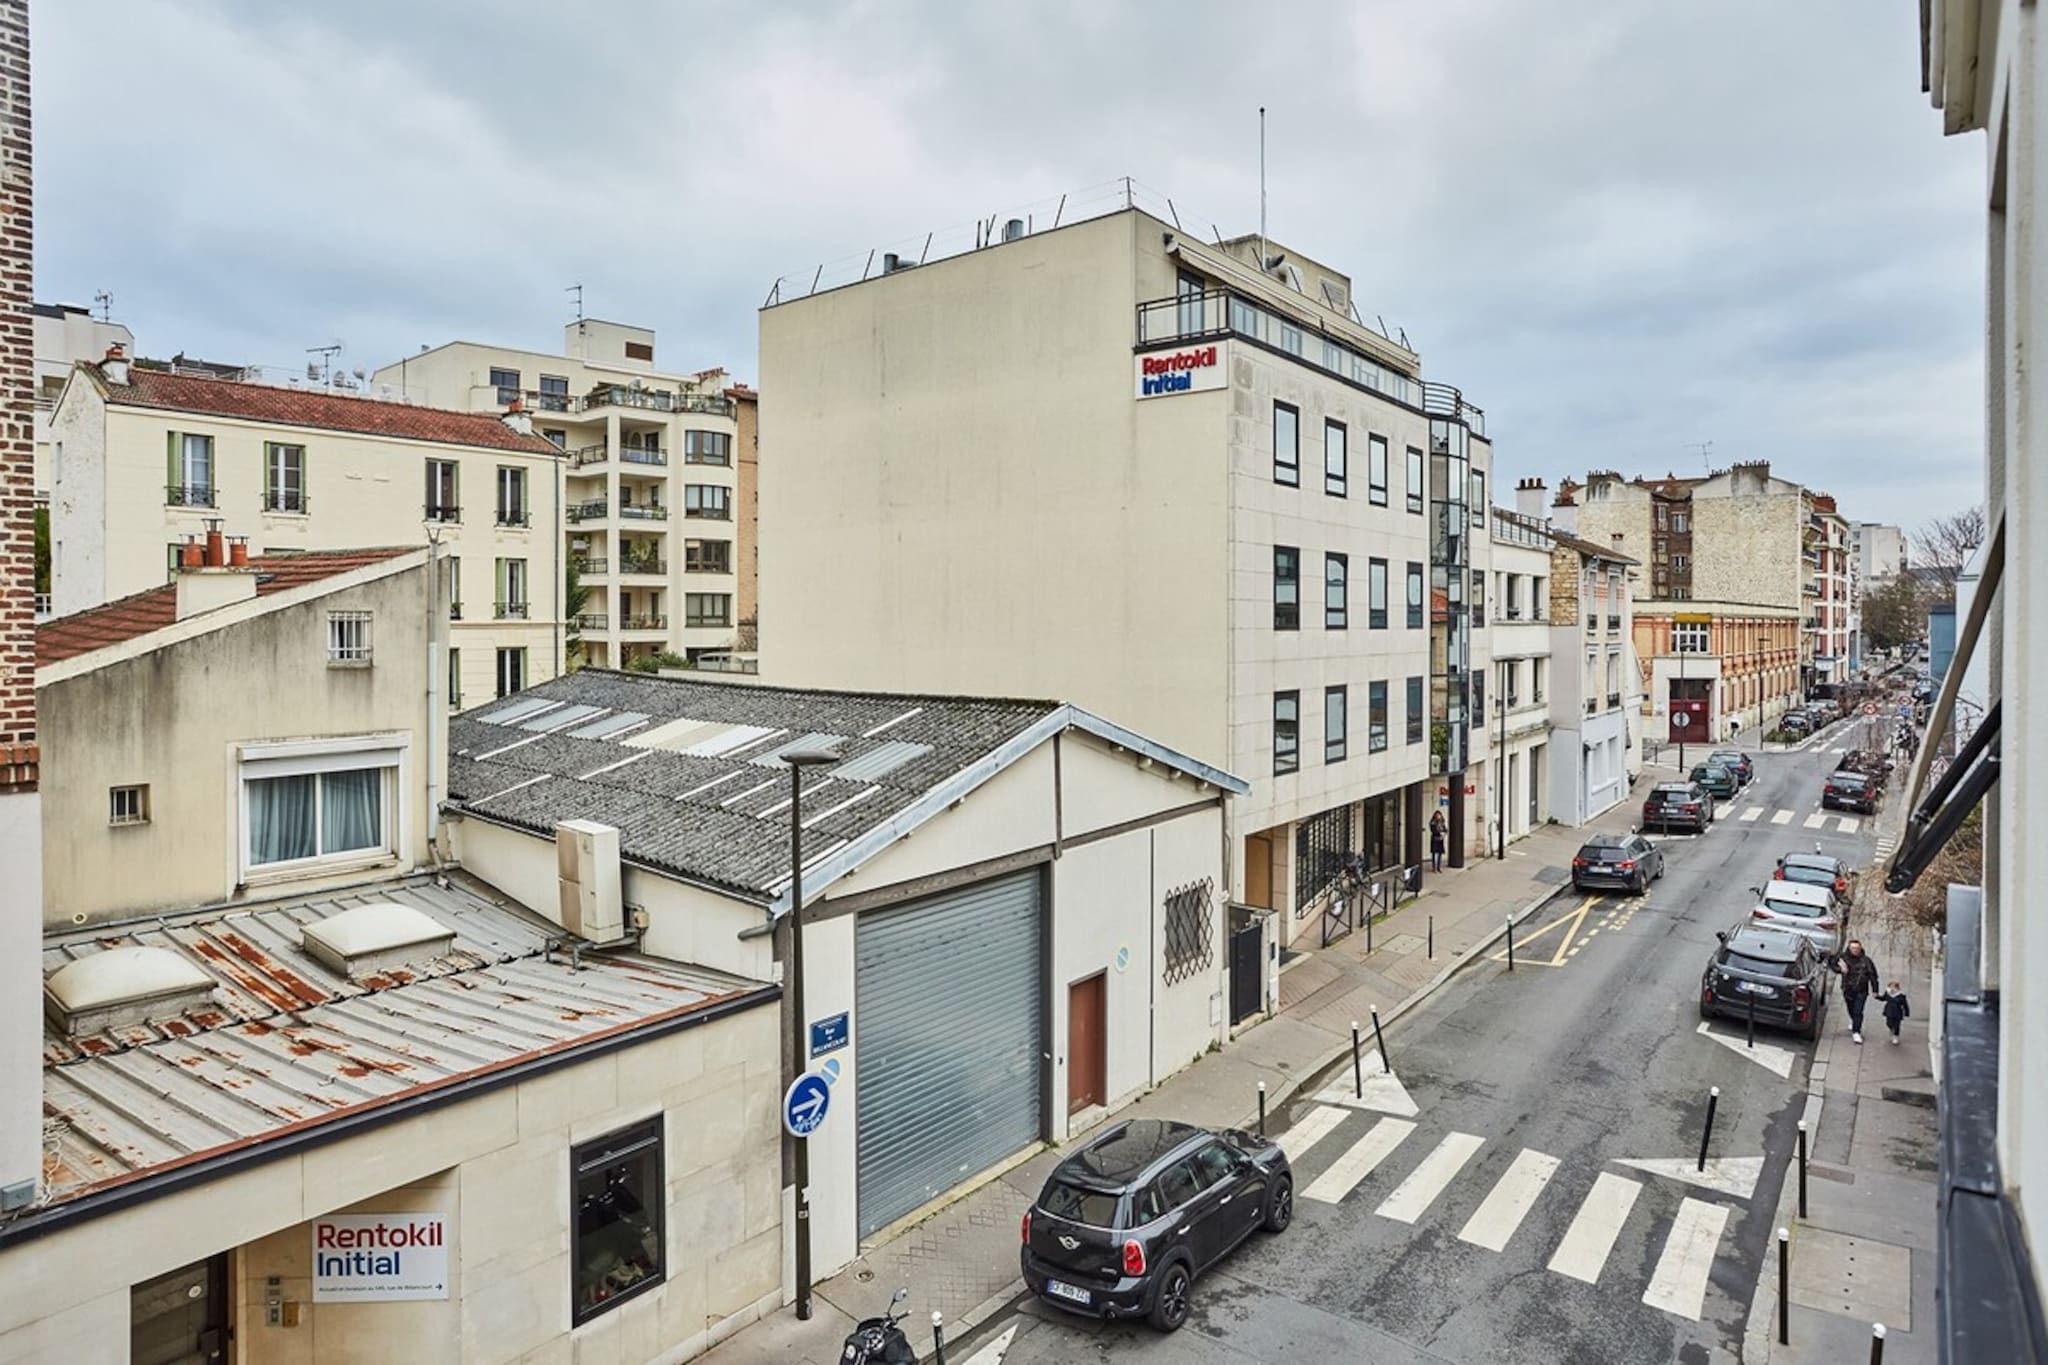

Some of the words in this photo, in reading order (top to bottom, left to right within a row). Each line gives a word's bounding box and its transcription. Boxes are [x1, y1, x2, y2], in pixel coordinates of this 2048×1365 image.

[1142, 346, 1217, 375] Rentokil
[1142, 371, 1191, 395] Initial
[318, 1222, 443, 1249] Rentokil
[317, 1251, 400, 1277] Initial
